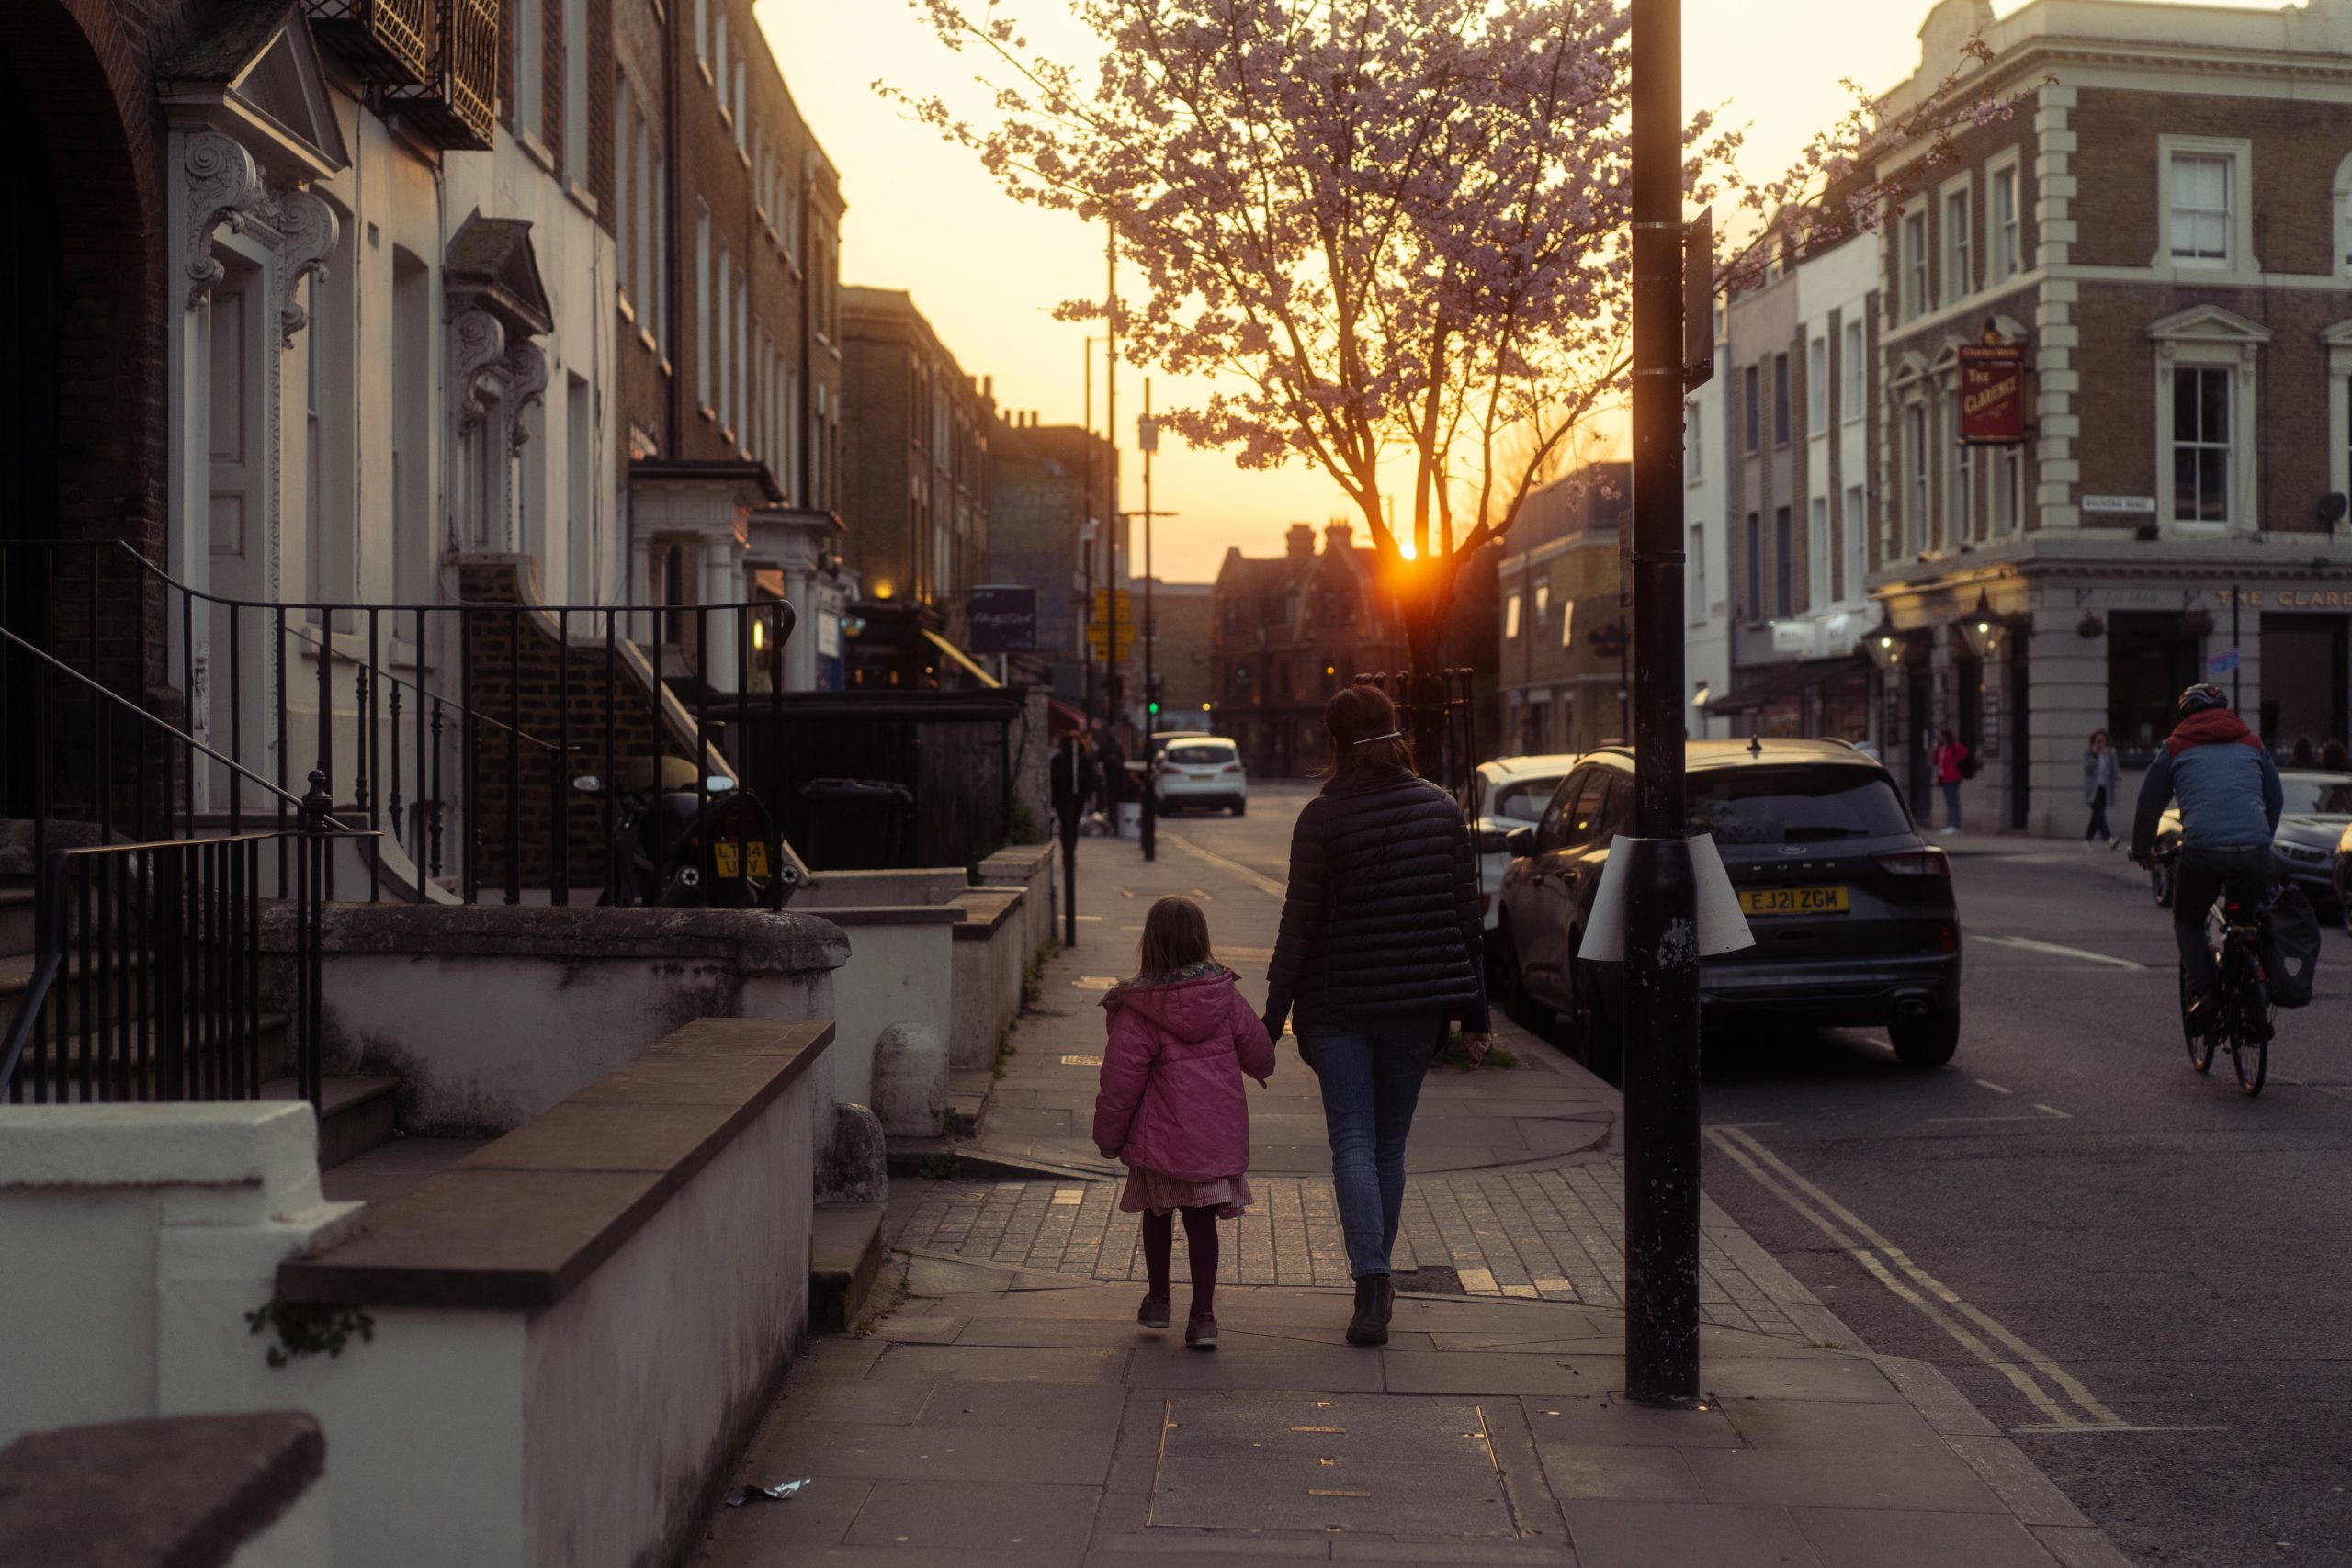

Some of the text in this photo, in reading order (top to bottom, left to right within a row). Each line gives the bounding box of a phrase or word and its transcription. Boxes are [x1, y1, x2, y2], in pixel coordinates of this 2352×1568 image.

[1968, 369, 1989, 383] THE
[2218, 590, 2263, 605] THE
[718, 843, 762, 859] LT4
[726, 859, 757, 873] UV
[1750, 889, 1838, 910] EJ21 ZGM
